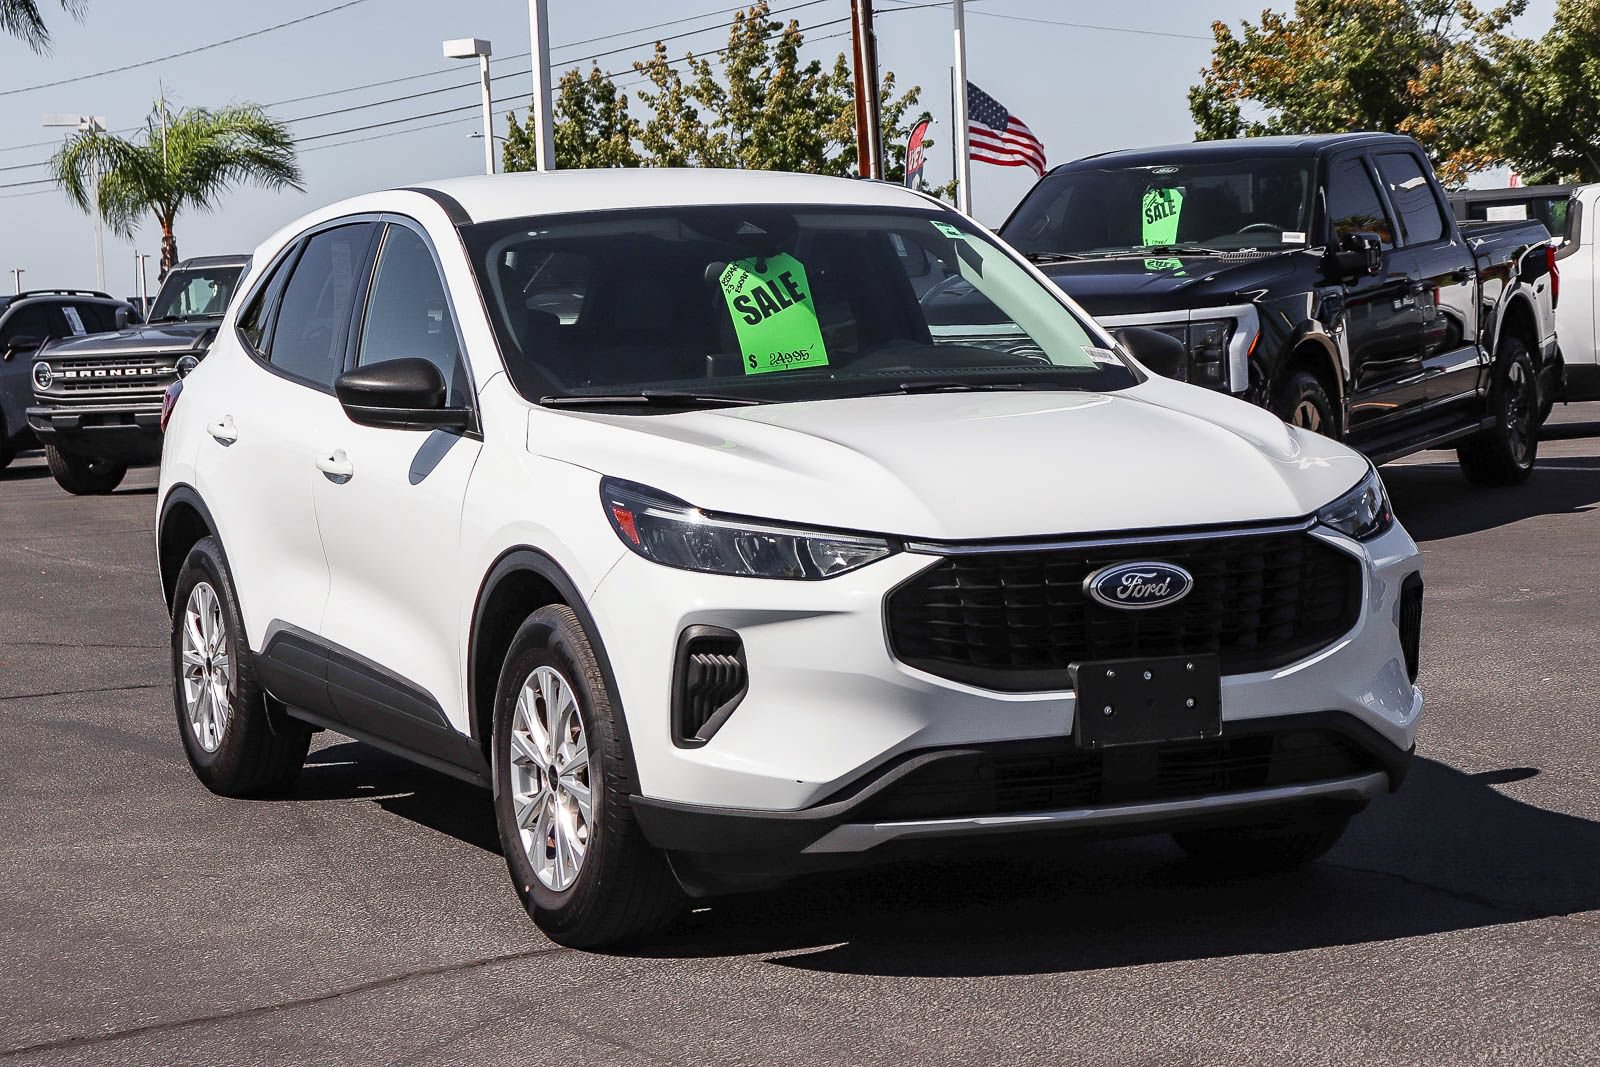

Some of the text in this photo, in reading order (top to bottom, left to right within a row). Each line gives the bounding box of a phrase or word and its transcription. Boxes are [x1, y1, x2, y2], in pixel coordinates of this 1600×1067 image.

[1145, 199, 1176, 224] SALE
[733, 270, 807, 325] SALE
[769, 349, 810, 365] 24995
[65, 368, 152, 378] BRONCO
[1117, 572, 1170, 599] Ford
